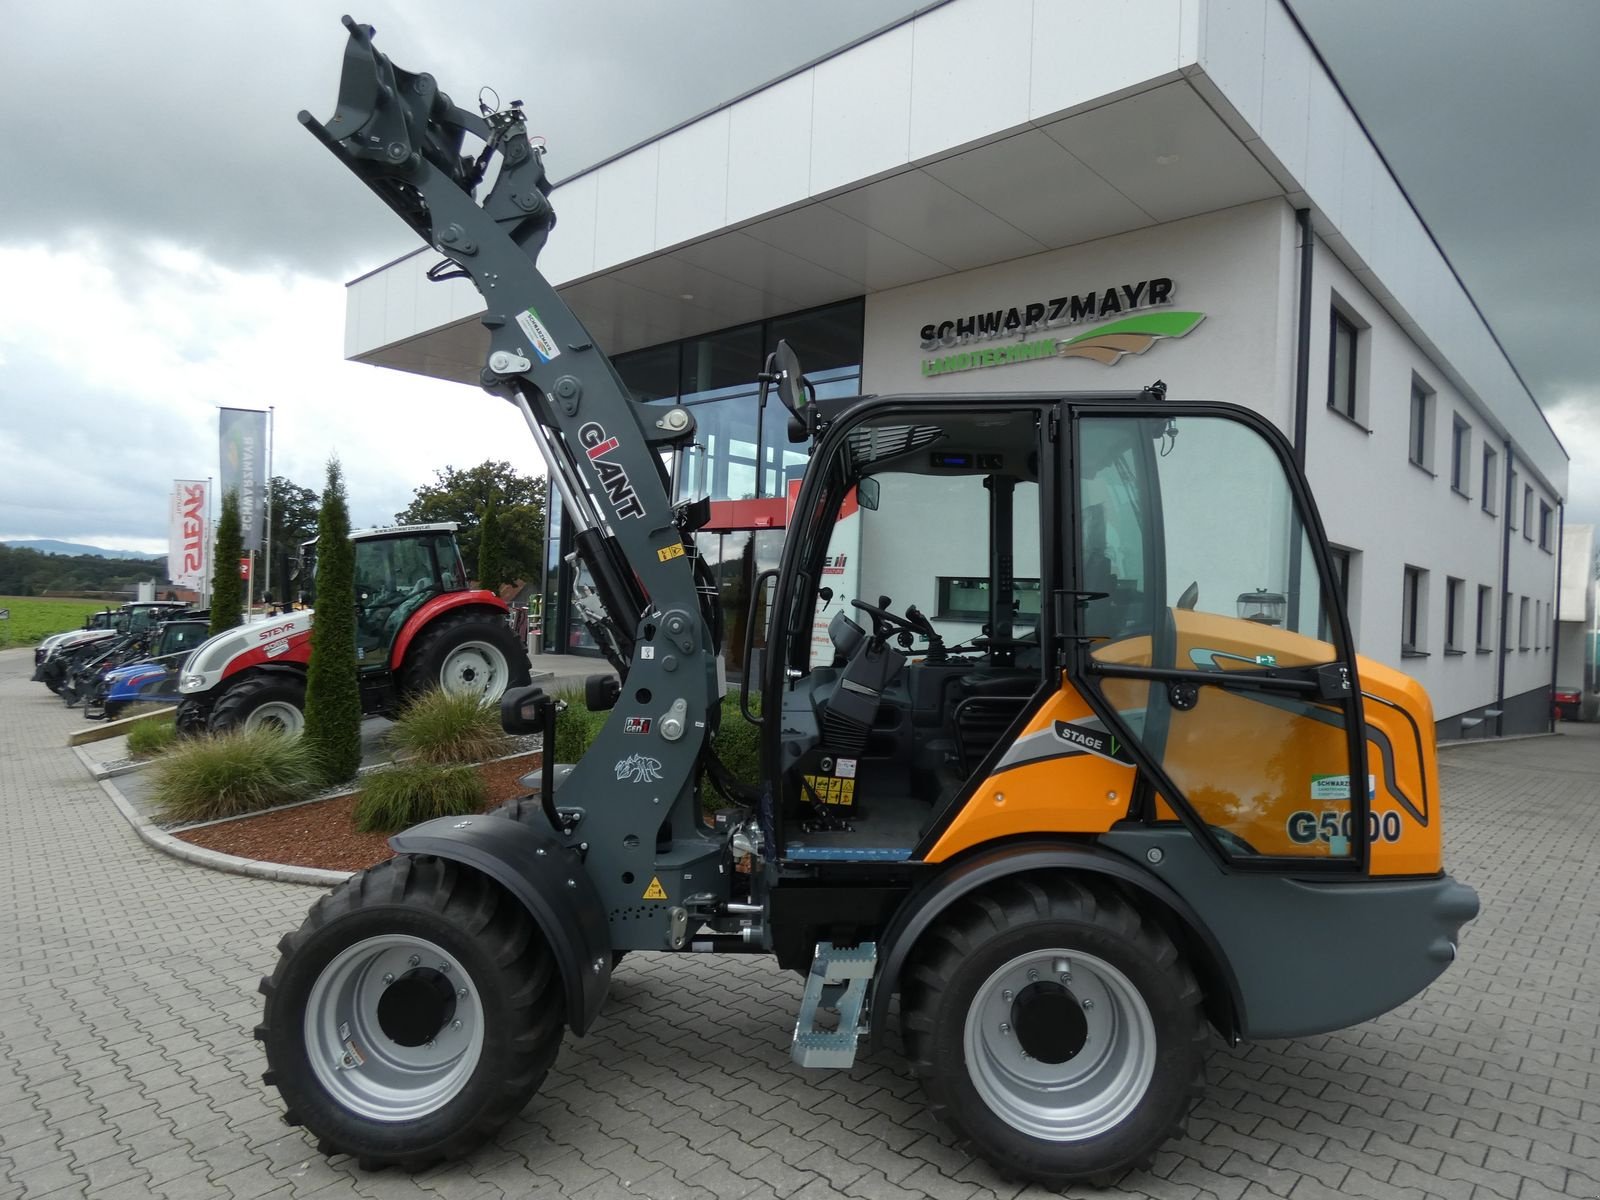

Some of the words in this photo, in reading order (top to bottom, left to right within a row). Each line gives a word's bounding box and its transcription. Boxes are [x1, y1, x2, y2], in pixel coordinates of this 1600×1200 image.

[919, 277, 1175, 349] SCHWARZMAYR
[259, 622, 295, 641] STEYR
[1062, 728, 1103, 750] STAGE
